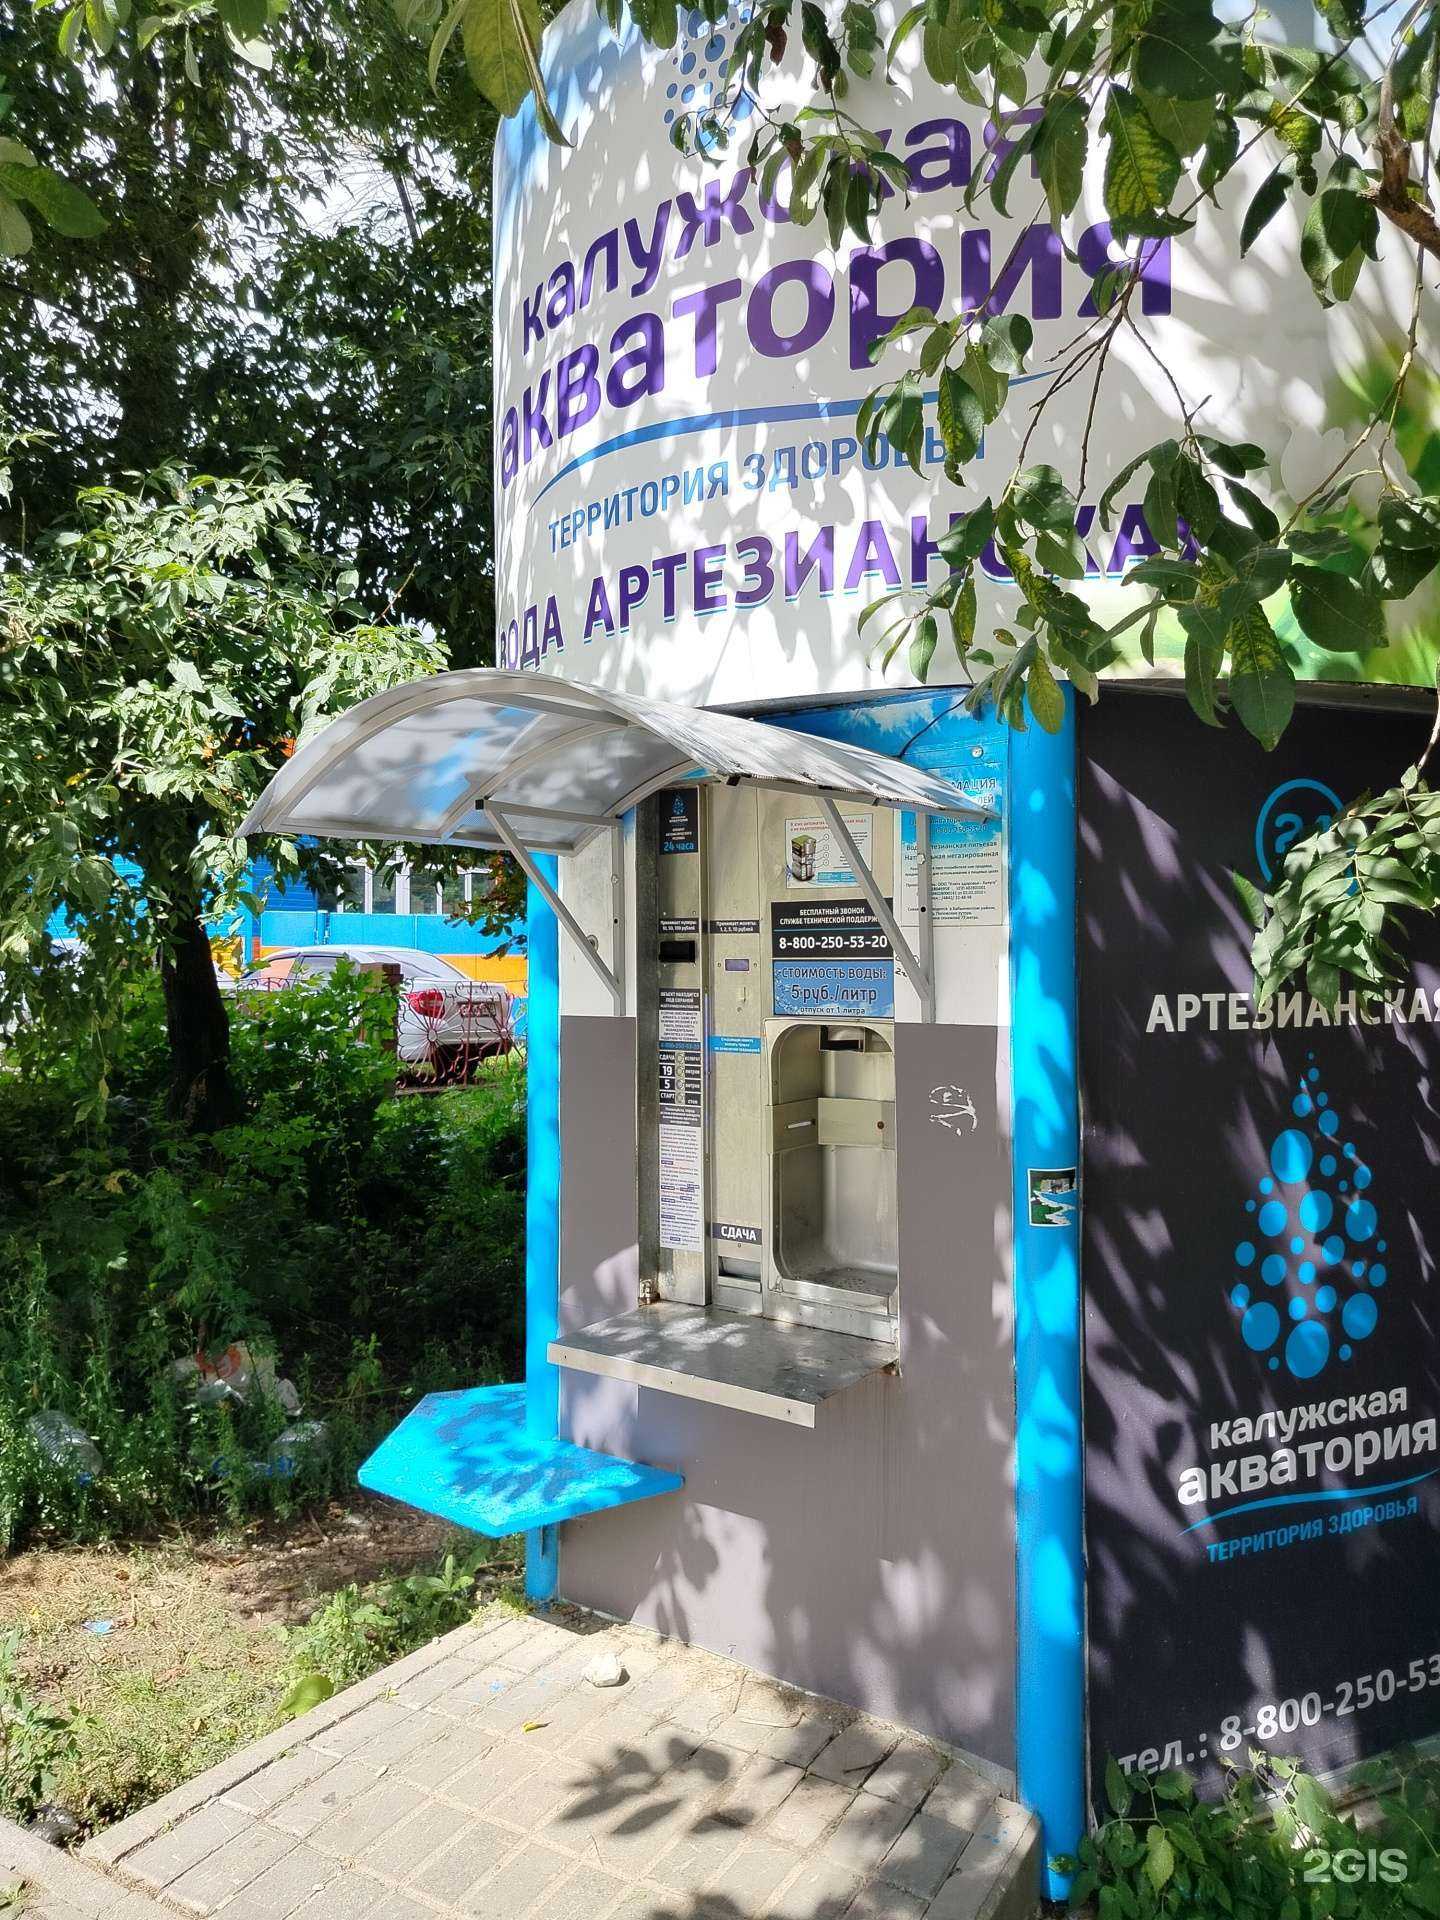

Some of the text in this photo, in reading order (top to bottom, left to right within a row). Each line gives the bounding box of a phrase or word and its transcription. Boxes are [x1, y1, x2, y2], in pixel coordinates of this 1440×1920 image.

[522, 108, 1046, 355] калужая
[502, 220, 1172, 490] акватория
[547, 425, 985, 554] ТЕРРИТОРИЯ ЗДОРОЬ
[583, 502, 1224, 643] АРТЕЗИАНА
[799, 906, 865, 916] БЕСПЛАТНЫЙ ЗВОНОК
[804, 915, 845, 925] ТЕХНИЧЕСКОЙ
[846, 916, 880, 924] ПОДДЕРЖ
[779, 935, 888, 950] 8-800-250-53-20
[781, 966, 846, 979] СТОИМОСТЬ
[848, 966, 887, 980] ВОДЫ:
[800, 1006, 824, 1014] отпуск
[1145, 987, 1440, 1033] АРТЕЗИАНСКА
[662, 1066, 673, 1076] 19
[664, 1079, 671, 1089] 5
[720, 1225, 757, 1241] СДАЧА
[1210, 1386, 1408, 1450] калужская
[1177, 1418, 1438, 1506] акватория
[1206, 1496, 1418, 1563] ТЕРРИТОРИЯ ЗДОРОВЬЯ
[1118, 1732, 1208, 1777] тел.:
